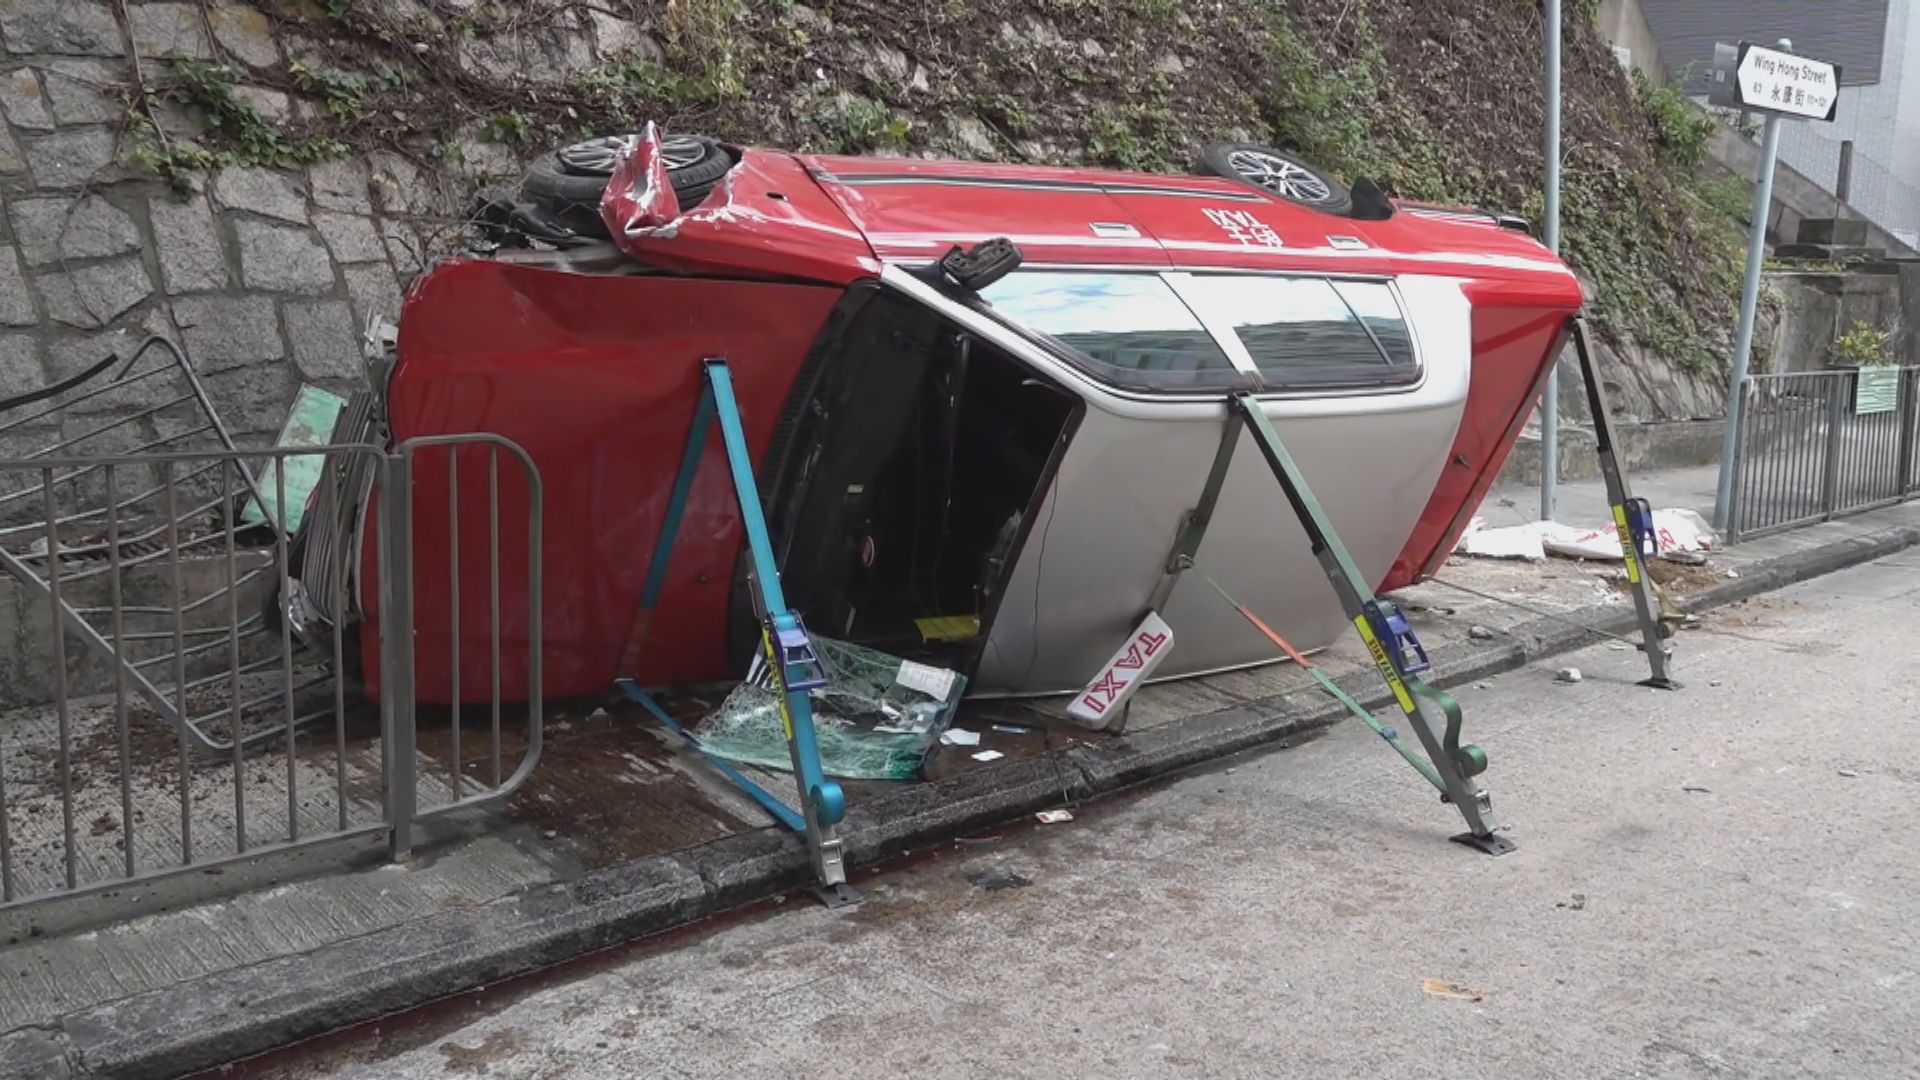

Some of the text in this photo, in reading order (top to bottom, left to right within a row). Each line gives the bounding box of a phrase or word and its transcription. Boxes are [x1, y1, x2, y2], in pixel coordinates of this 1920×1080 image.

[1754, 55, 1827, 84] Wing Hong Street
[1770, 82, 1805, 107] 永康街
[1082, 631, 1168, 713] TAXI
